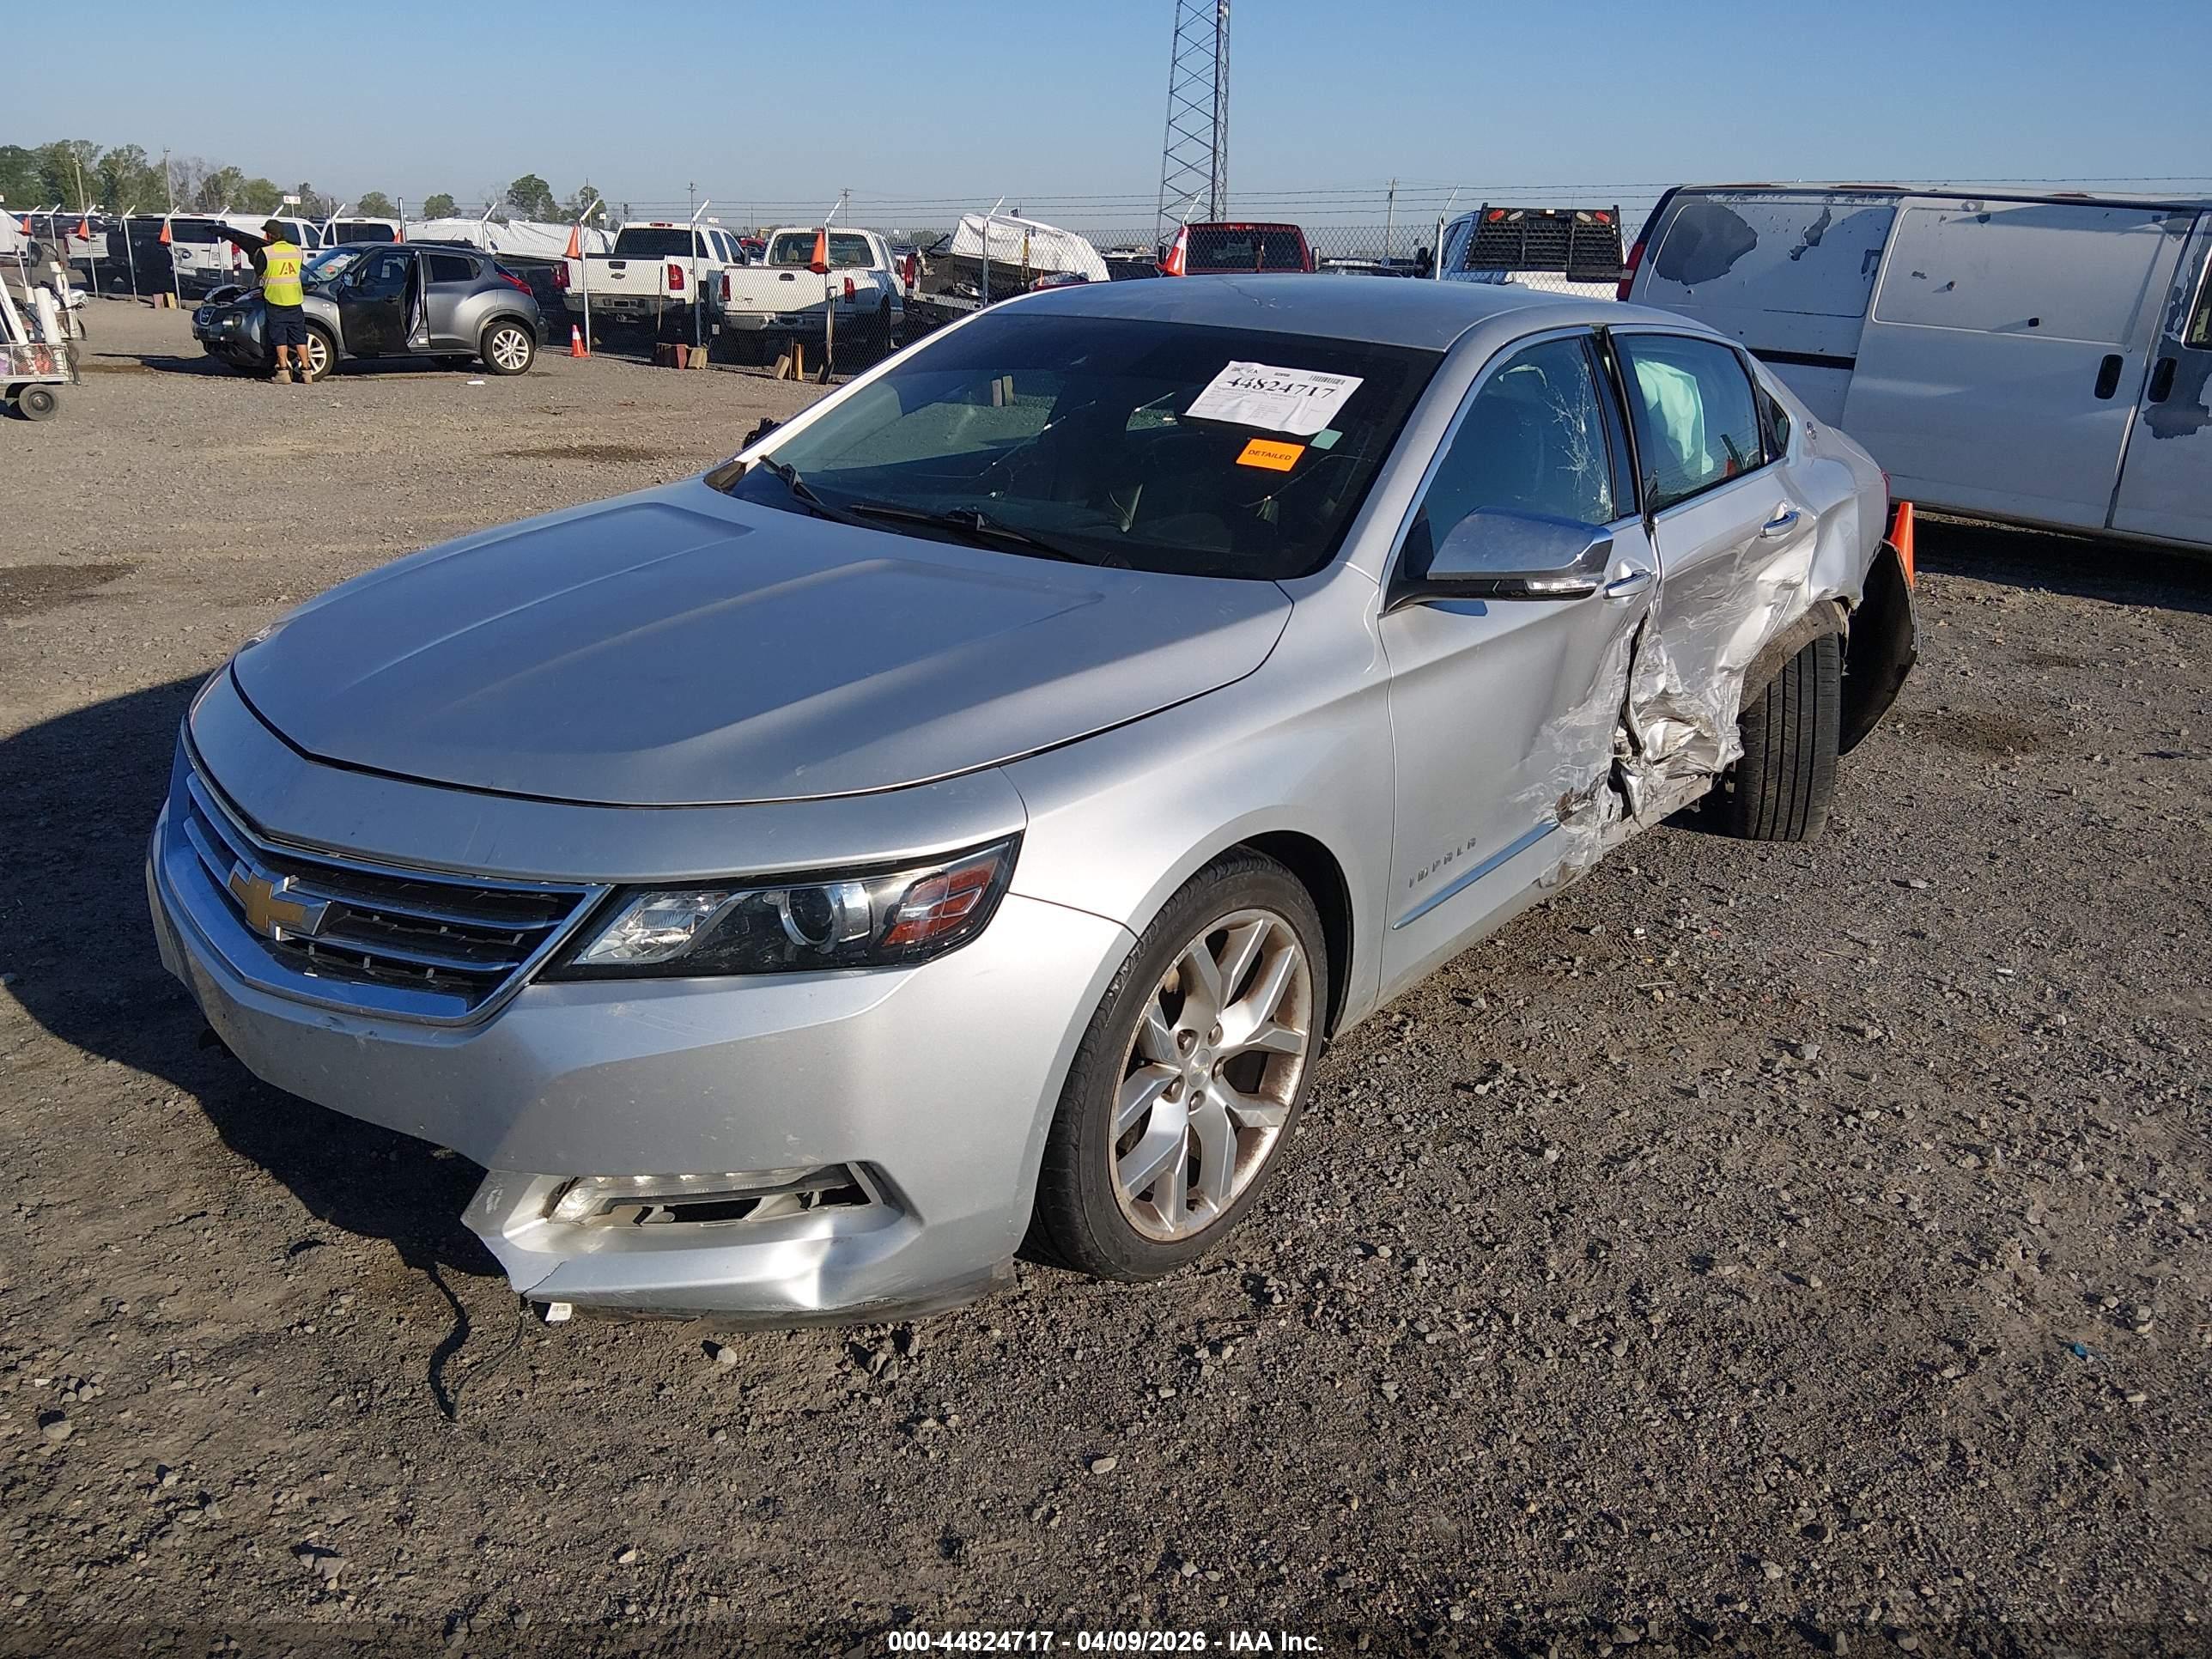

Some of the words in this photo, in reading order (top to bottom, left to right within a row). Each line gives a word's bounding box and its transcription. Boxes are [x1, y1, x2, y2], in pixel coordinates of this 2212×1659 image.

[1225, 376, 1336, 399] 44824717
[1248, 449, 1291, 460] DETAILED
[1409, 837, 1476, 888] IMPALA
